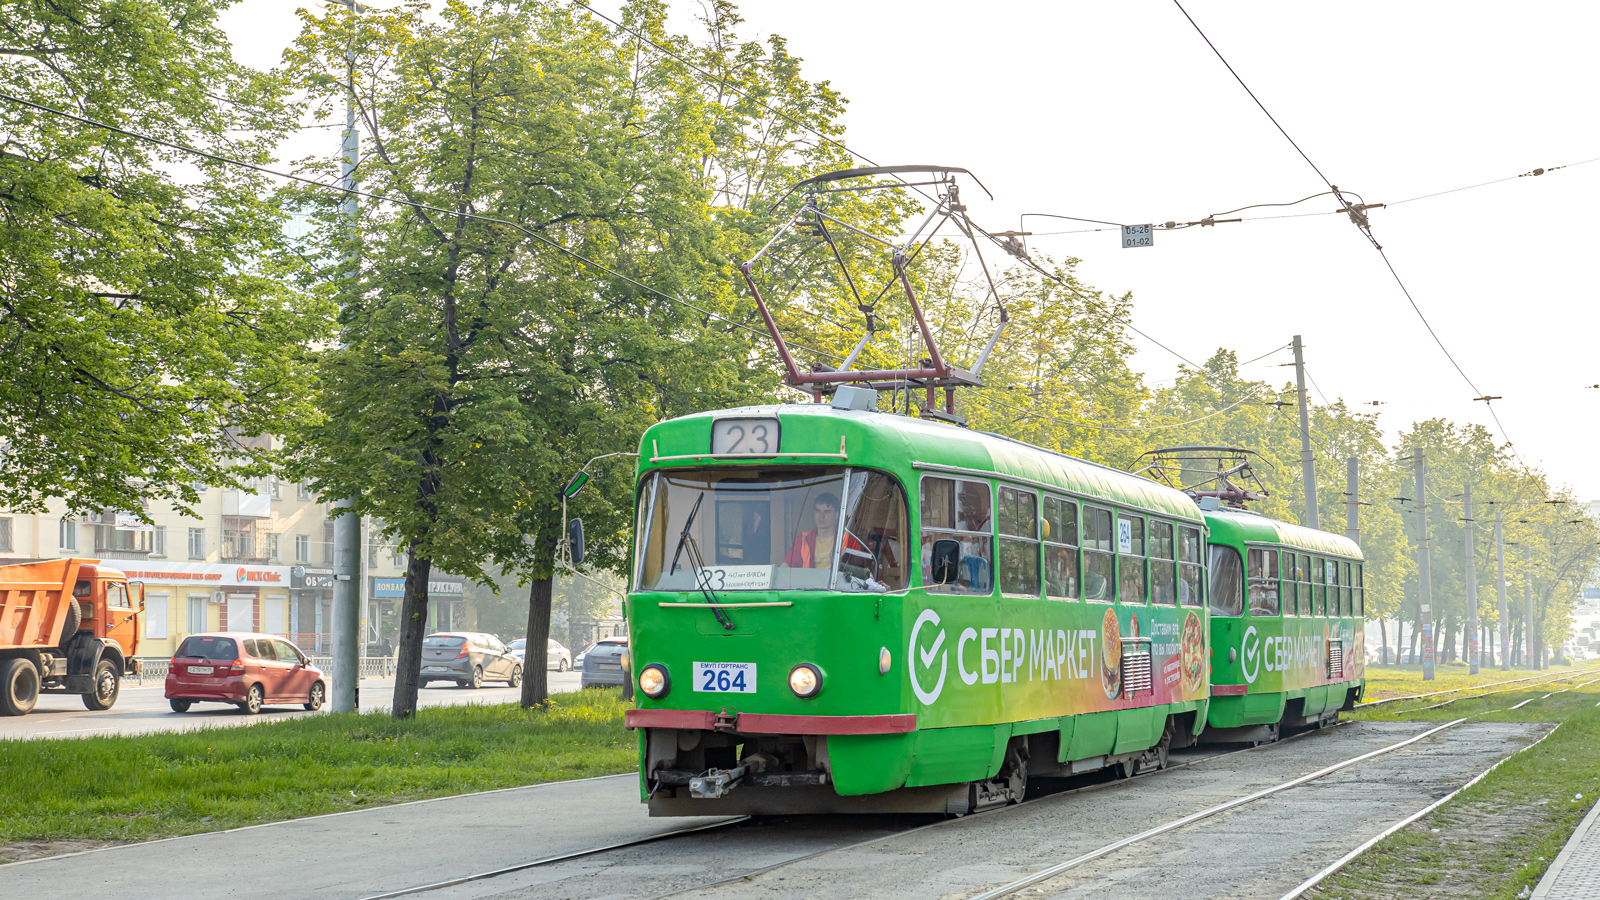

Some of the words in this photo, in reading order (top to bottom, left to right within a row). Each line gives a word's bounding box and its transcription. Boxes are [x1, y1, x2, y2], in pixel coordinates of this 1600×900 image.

[1126, 237, 1150, 246] 01-02
[727, 424, 769, 453] 23
[1120, 522, 1130, 544] 264
[263, 570, 281, 582] Clinic
[697, 569, 726, 590] 23
[376, 583, 406, 591] ЛОМБАР
[427, 581, 463, 593] ТРУКТУРА
[957, 627, 1026, 686] СБЕР
[1029, 628, 1097, 682] МАРКЕТ
[1264, 635, 1293, 672] СБЕР
[1293, 634, 1322, 669] МАРКЕТ
[702, 669, 747, 691] 264
